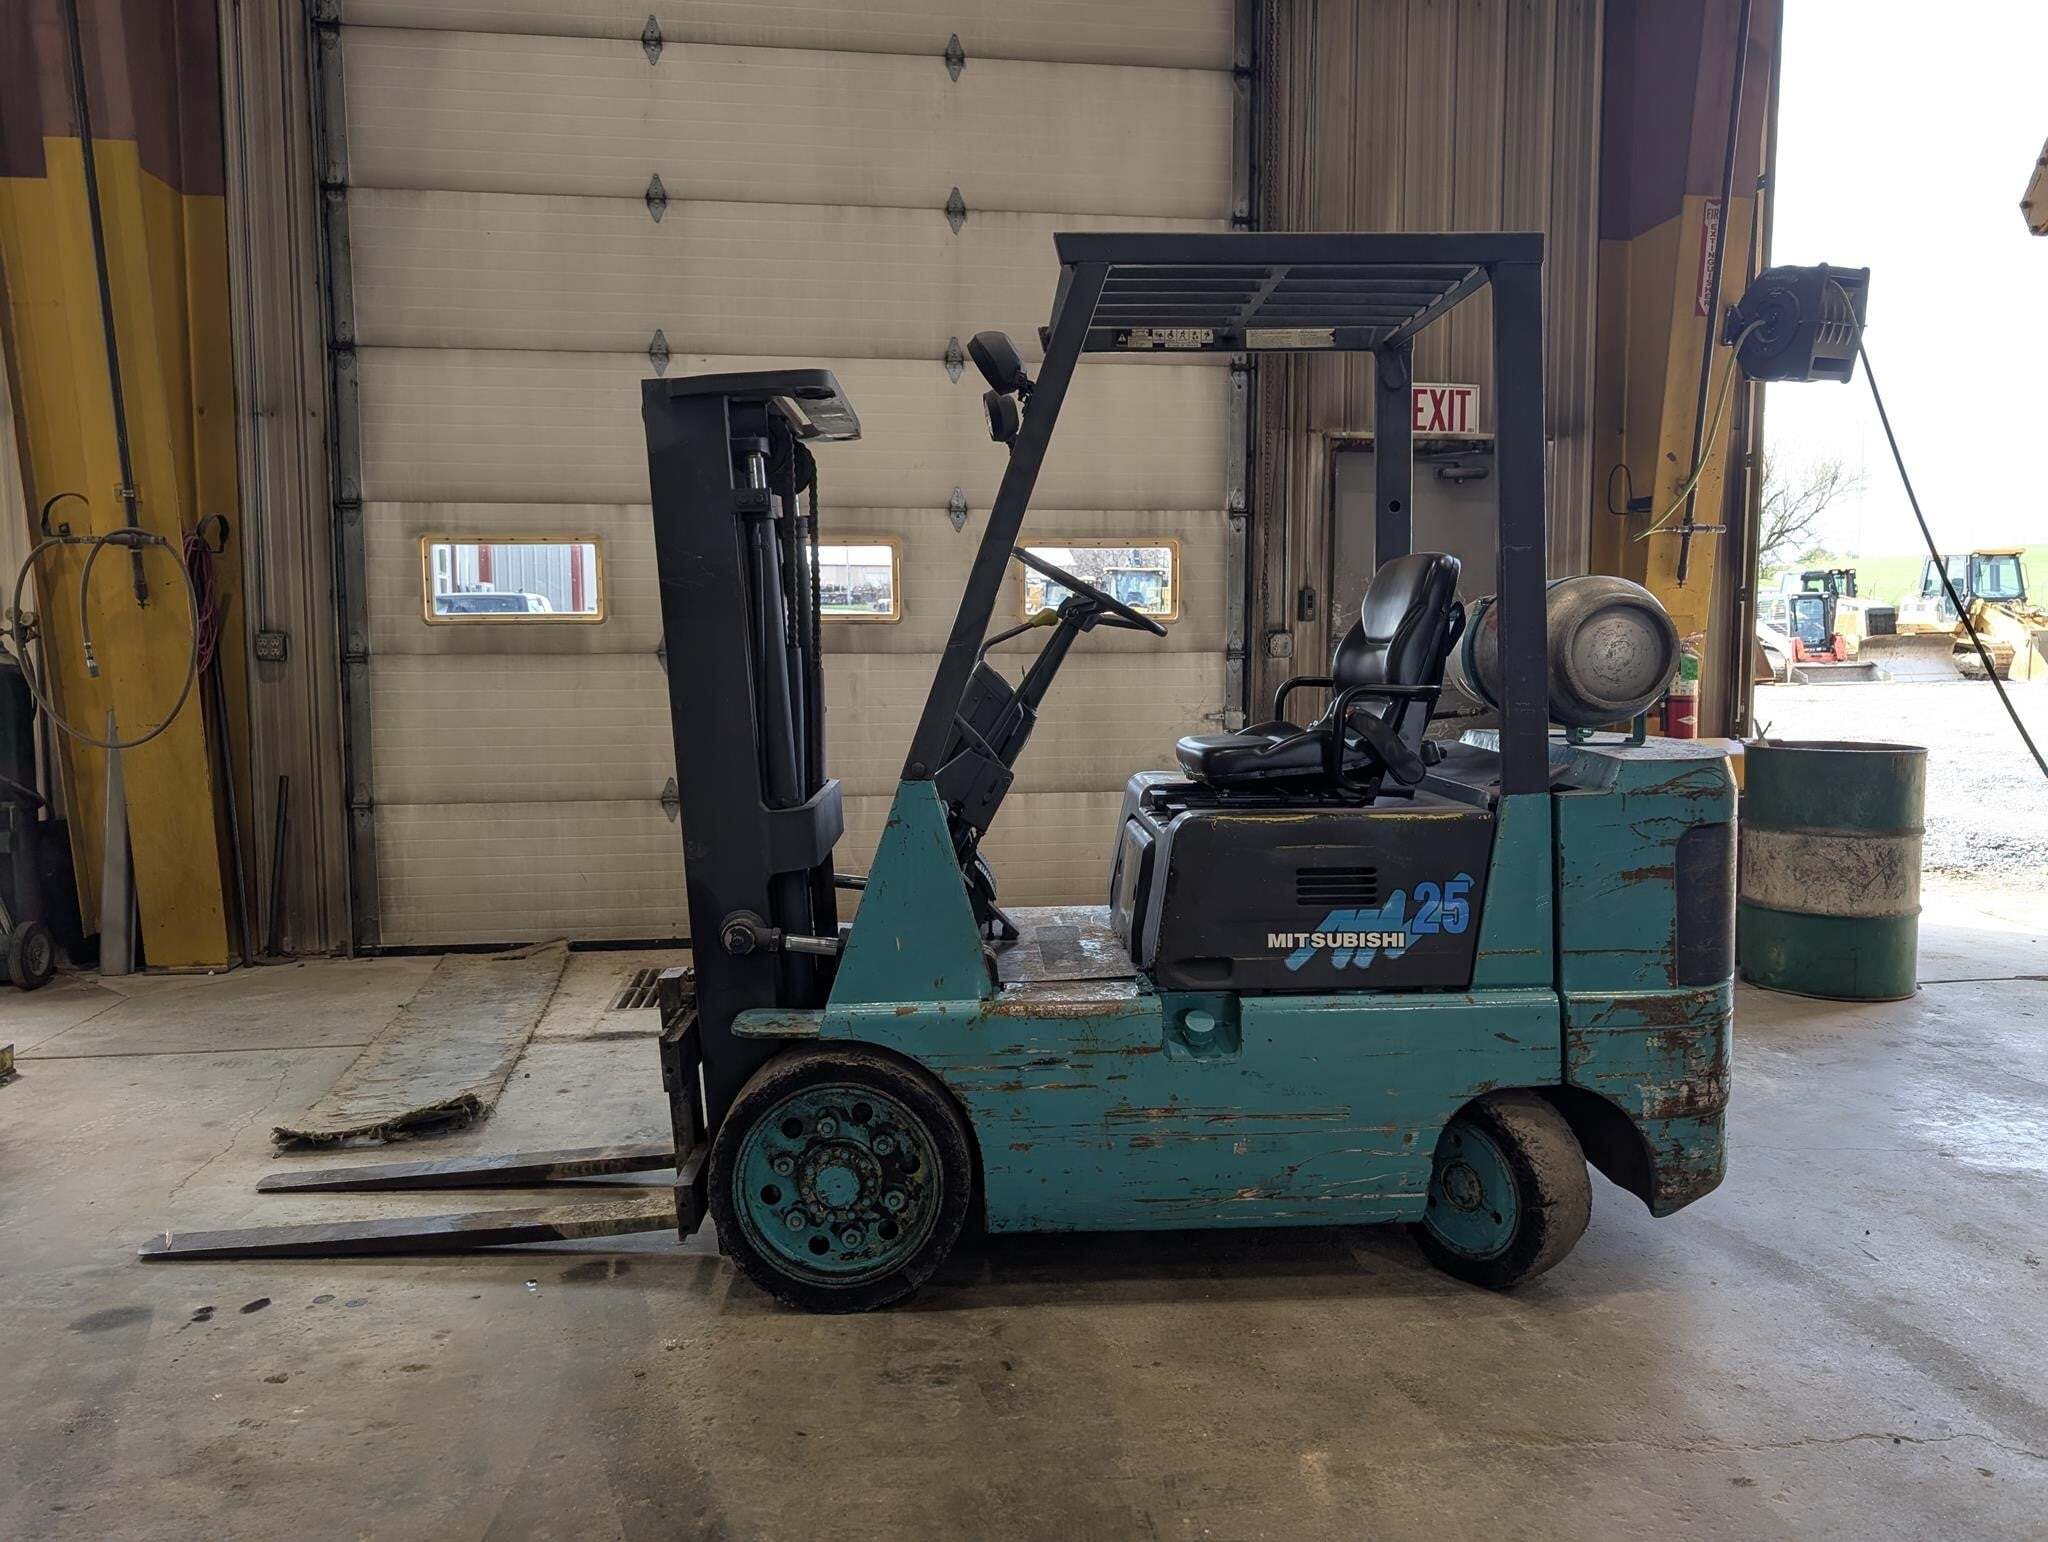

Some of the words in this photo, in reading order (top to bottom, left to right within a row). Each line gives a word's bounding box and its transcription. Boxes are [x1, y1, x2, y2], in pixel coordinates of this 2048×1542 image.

[1706, 208, 1720, 220] FIR
[1412, 388, 1472, 432] EXIT
[1411, 880, 1470, 934] 25
[1267, 932, 1405, 948] MITSUBISHI
